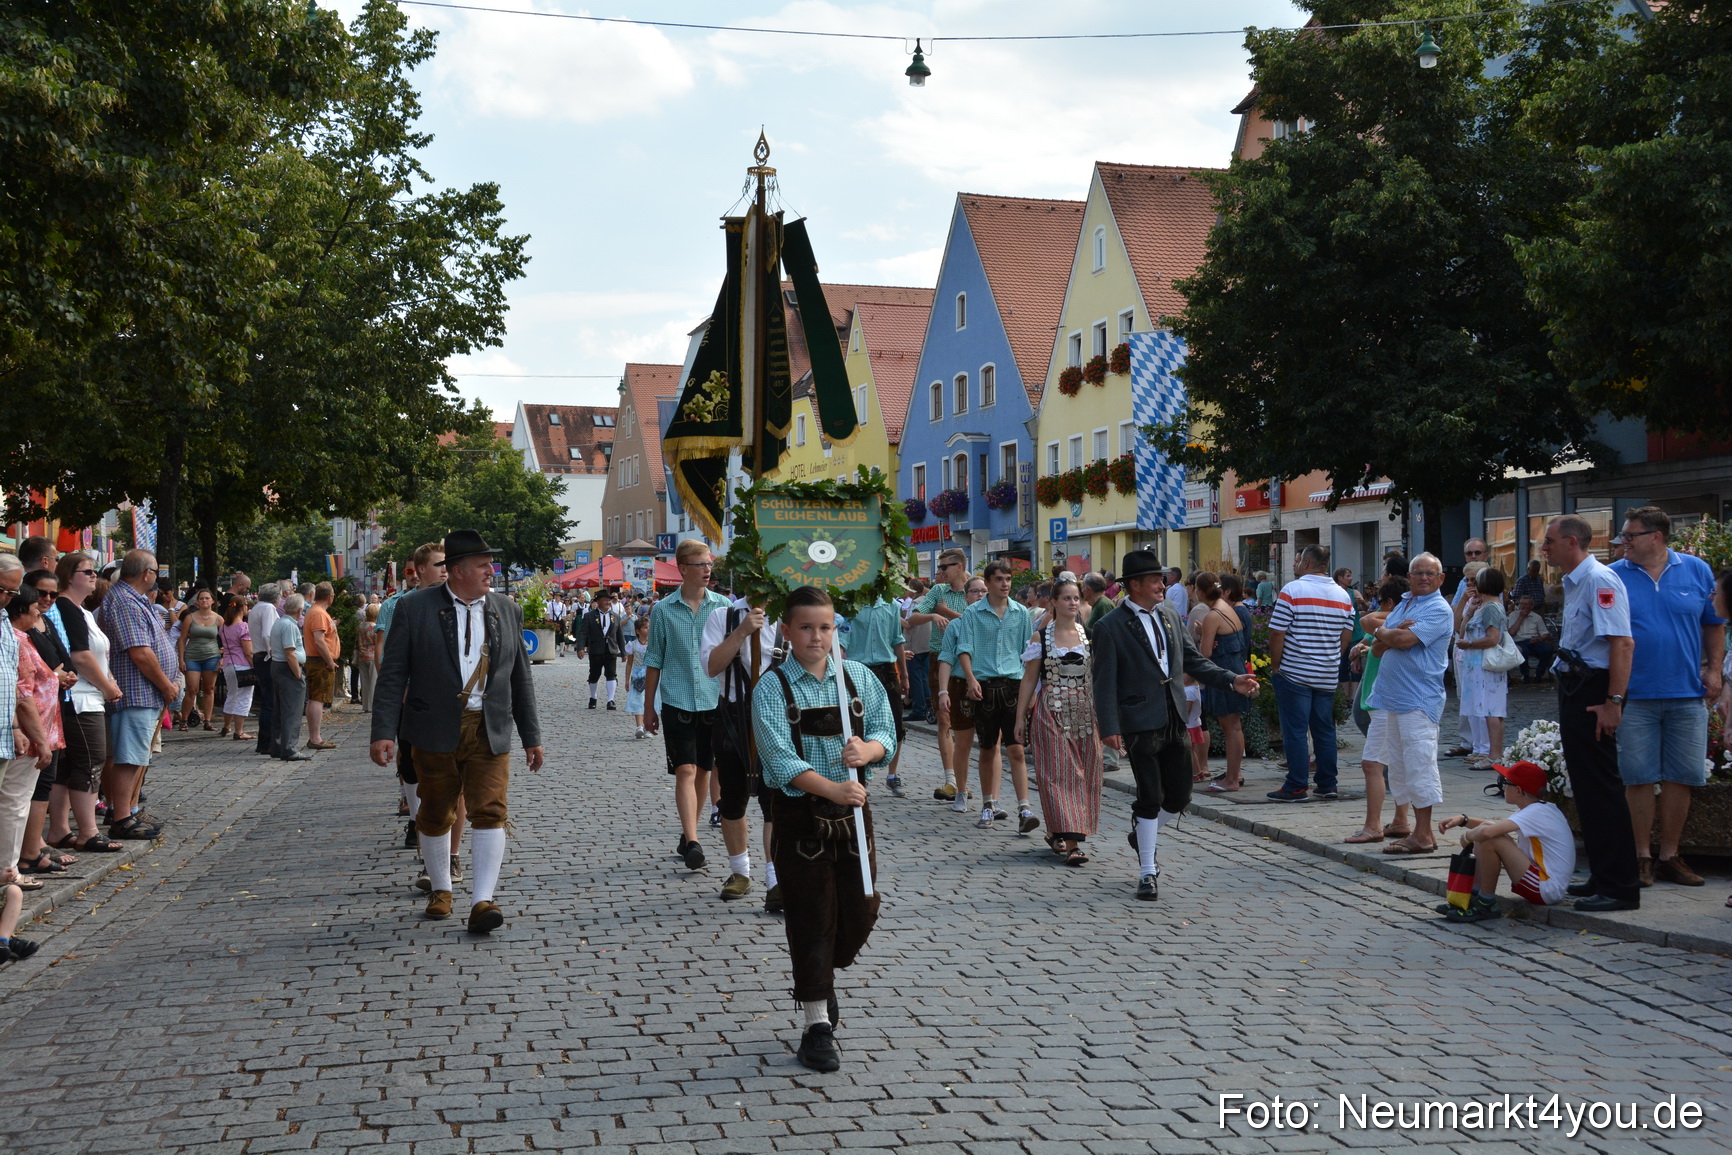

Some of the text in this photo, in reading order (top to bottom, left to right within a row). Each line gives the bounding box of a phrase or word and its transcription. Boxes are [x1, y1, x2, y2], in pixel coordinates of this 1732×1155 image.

[790, 463, 806, 480] HOTEL
[774, 510, 868, 522] EICHENLAUB
[1053, 521, 1064, 540] P
[781, 559, 872, 588] PAVELSBACH
